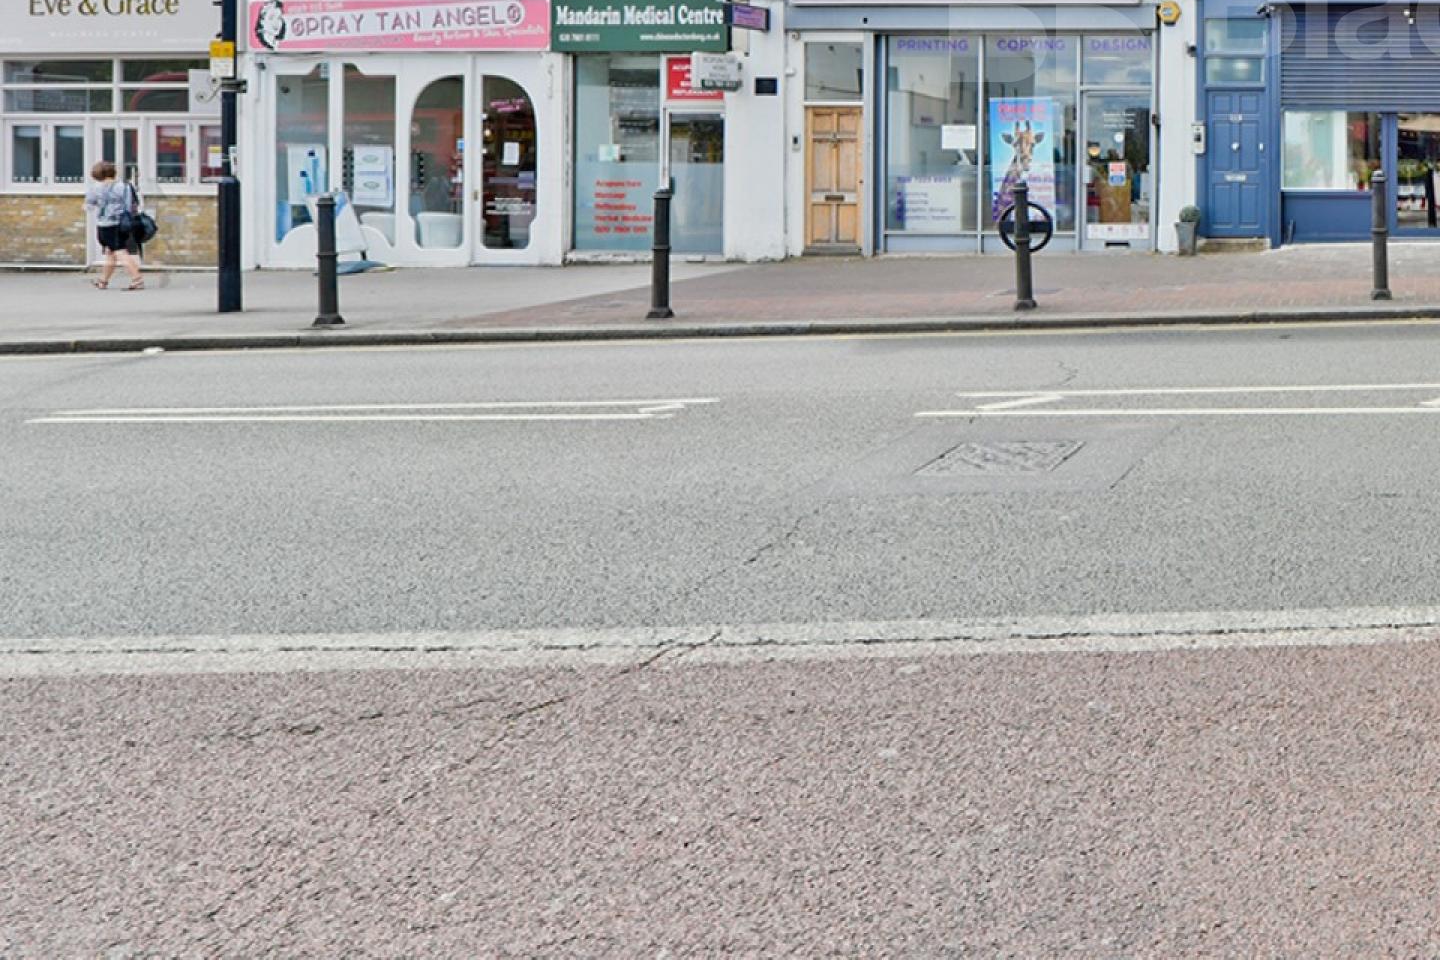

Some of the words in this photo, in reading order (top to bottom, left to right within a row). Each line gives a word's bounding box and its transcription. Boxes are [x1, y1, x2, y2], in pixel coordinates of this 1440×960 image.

[376, 11, 421, 32] TAN
[556, 5, 621, 25] Mandarin
[624, 5, 675, 25] Medical
[678, 5, 724, 25] Centre
[896, 39, 969, 51] PRINTING
[996, 39, 1066, 51] COPYING
[1090, 39, 1150, 51] DESIGN
